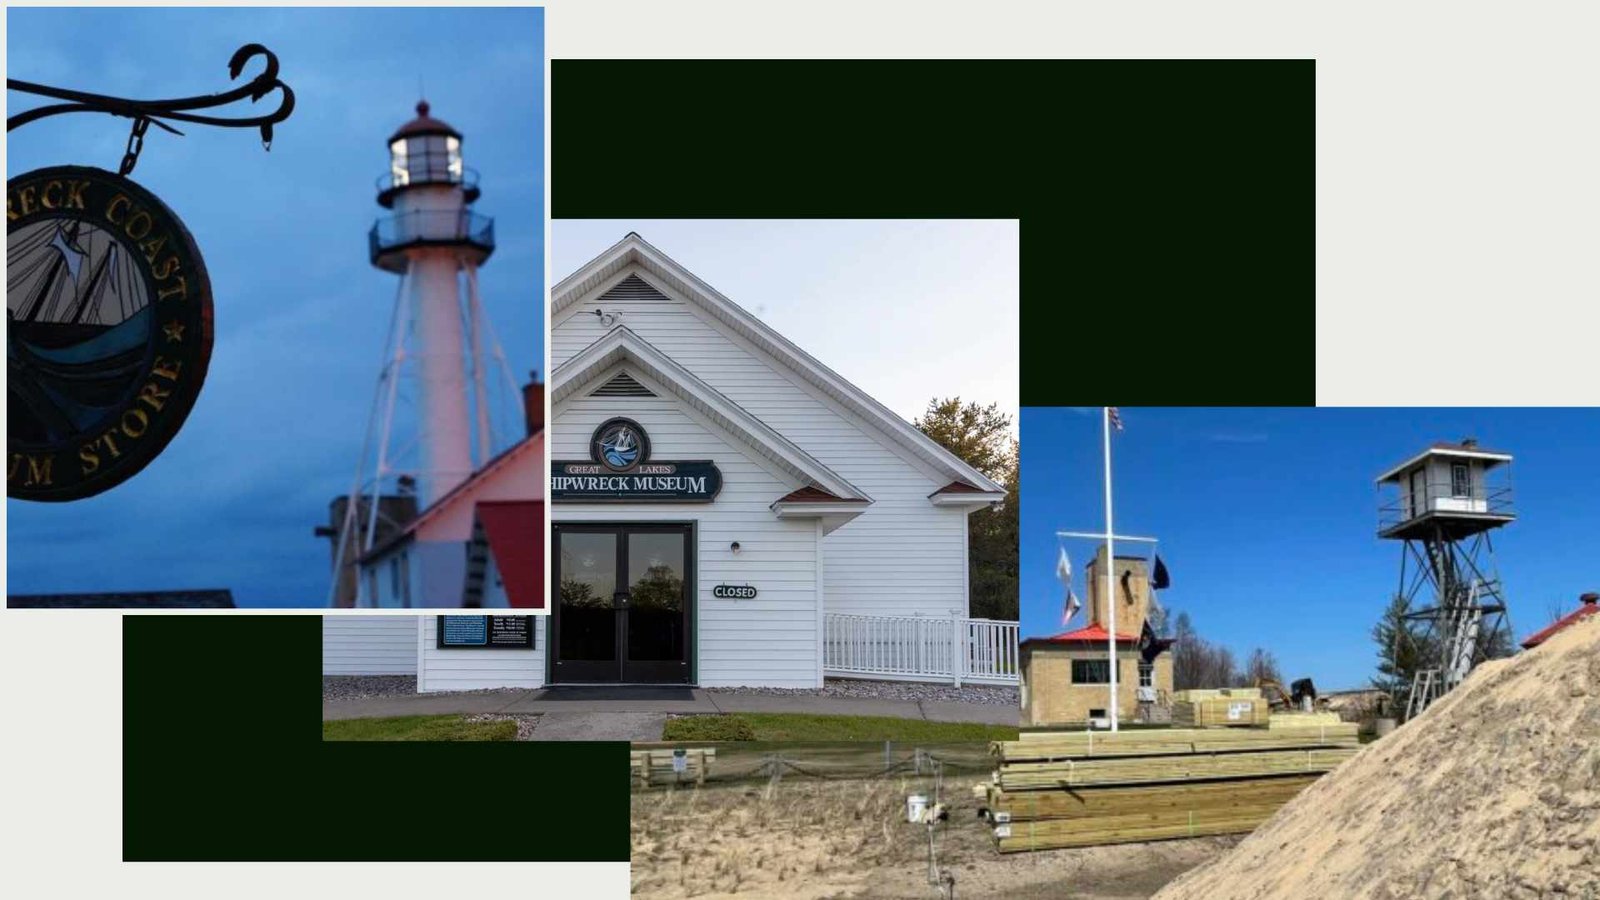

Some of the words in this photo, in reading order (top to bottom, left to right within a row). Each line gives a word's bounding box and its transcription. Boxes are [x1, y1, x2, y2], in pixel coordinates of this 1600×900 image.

[105, 194, 188, 301] COAST
[79, 359, 182, 474] STORE
[569, 465, 600, 474] GREAT
[639, 465, 671, 474] LAKES
[551, 476, 630, 491] HIPWRECK
[633, 476, 706, 494] MUSEUM
[714, 586, 756, 598] CLOSED
